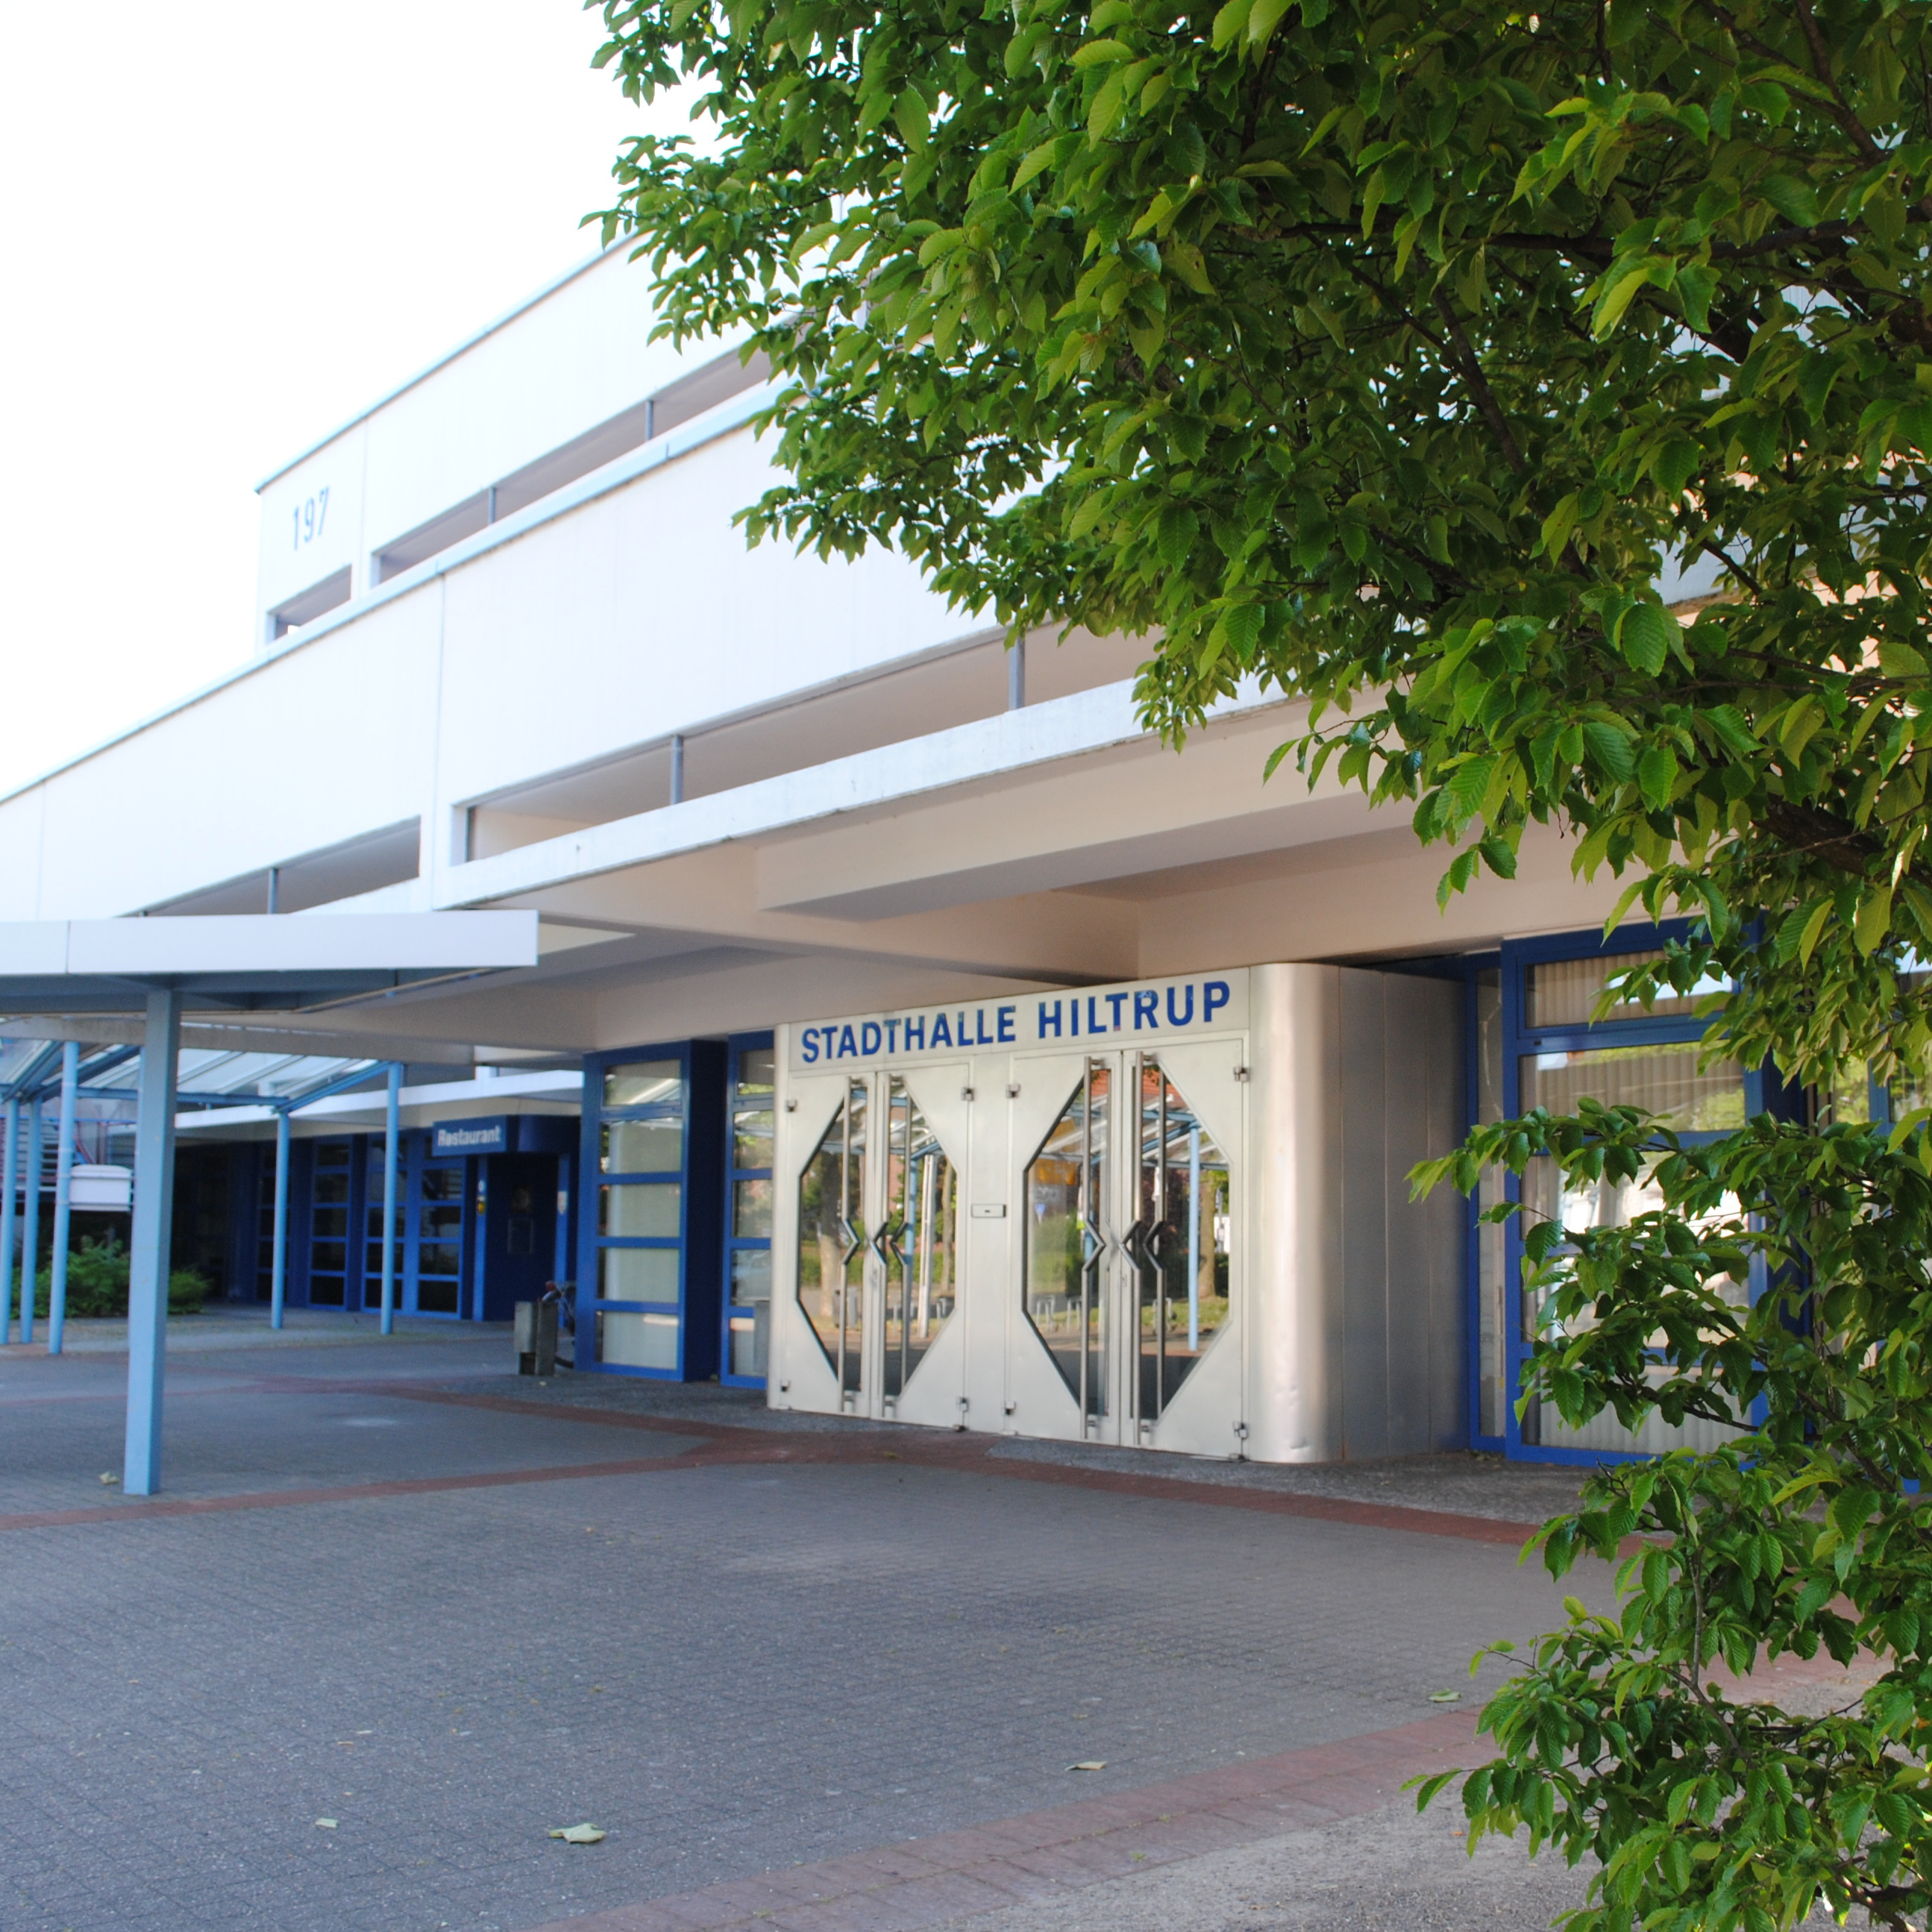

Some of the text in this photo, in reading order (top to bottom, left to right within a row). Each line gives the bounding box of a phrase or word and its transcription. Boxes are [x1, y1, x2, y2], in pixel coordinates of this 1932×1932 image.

[293, 486, 329, 551] 197
[801, 980, 1230, 1063] STADTHALLE HILTRUP
[438, 1125, 501, 1147] Restaurant
